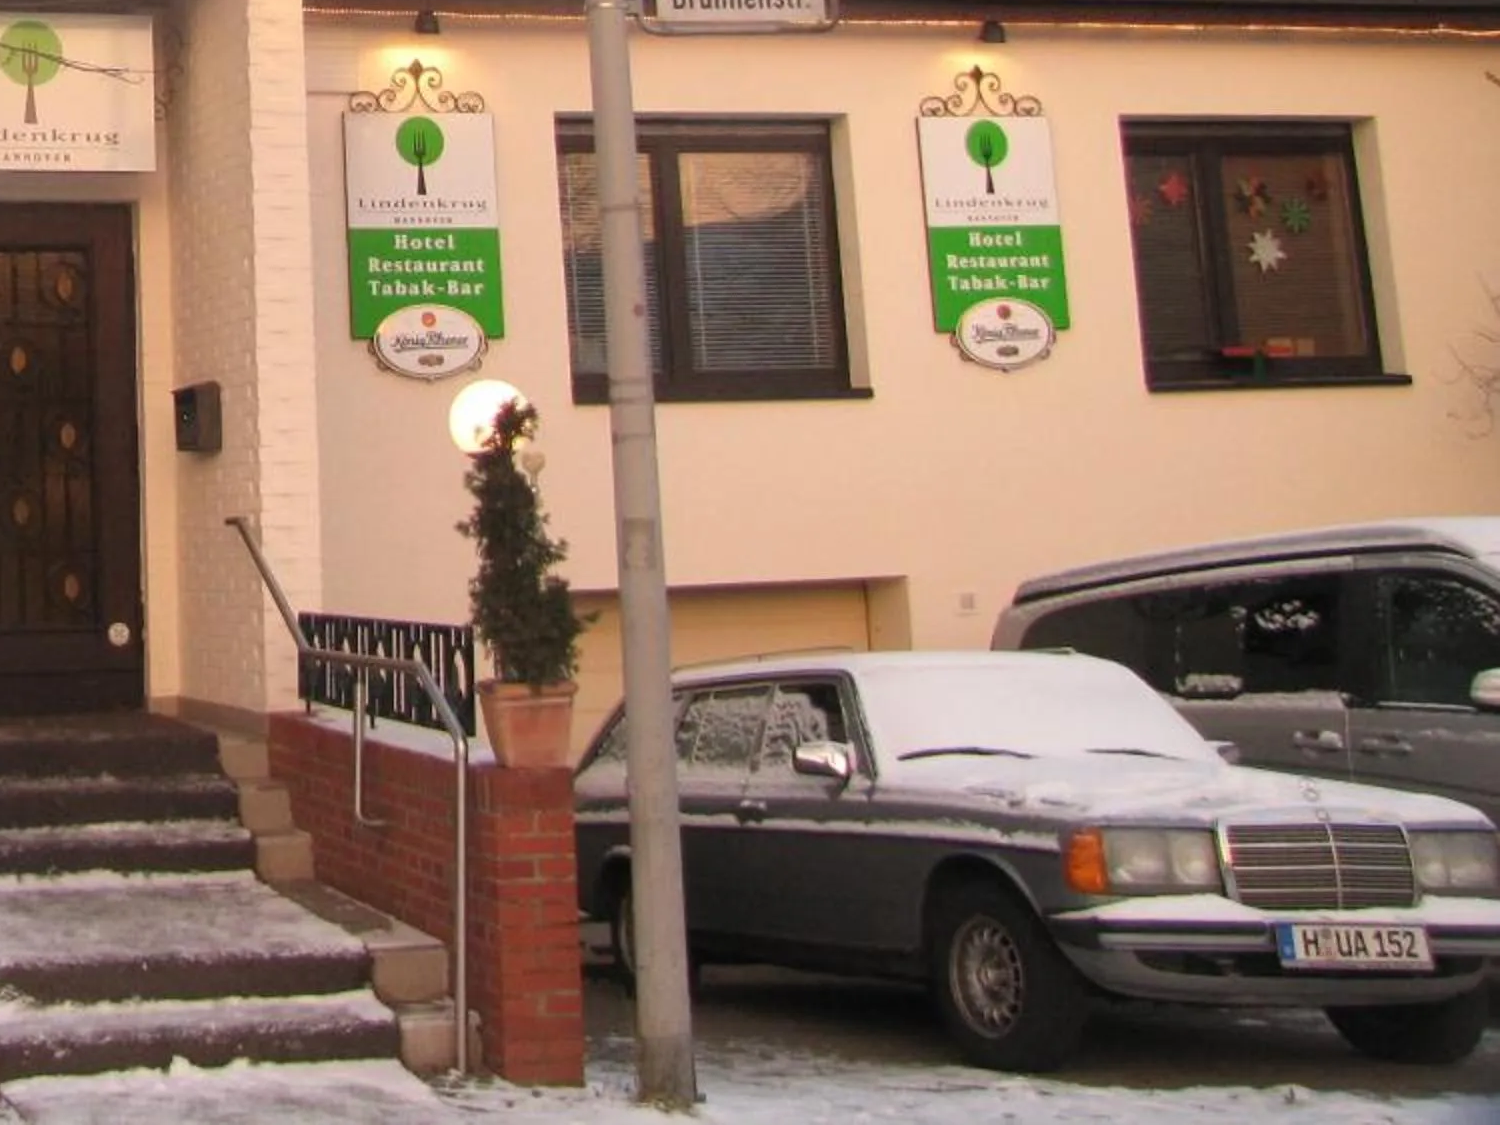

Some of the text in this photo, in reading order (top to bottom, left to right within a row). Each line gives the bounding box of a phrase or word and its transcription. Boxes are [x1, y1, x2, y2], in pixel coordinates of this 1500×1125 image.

[358, 197, 487, 211] Lindenkrug
[935, 195, 1049, 209] Lindenkrug
[394, 235, 455, 250] Hotel
[968, 231, 1023, 247] Hotel
[368, 257, 485, 273] Restaurant
[947, 254, 1050, 269] Restaurant
[368, 280, 485, 296] Tabak-Bar
[948, 275, 1051, 291] Tabak-Bar
[1303, 930, 1419, 958] H UA 152
